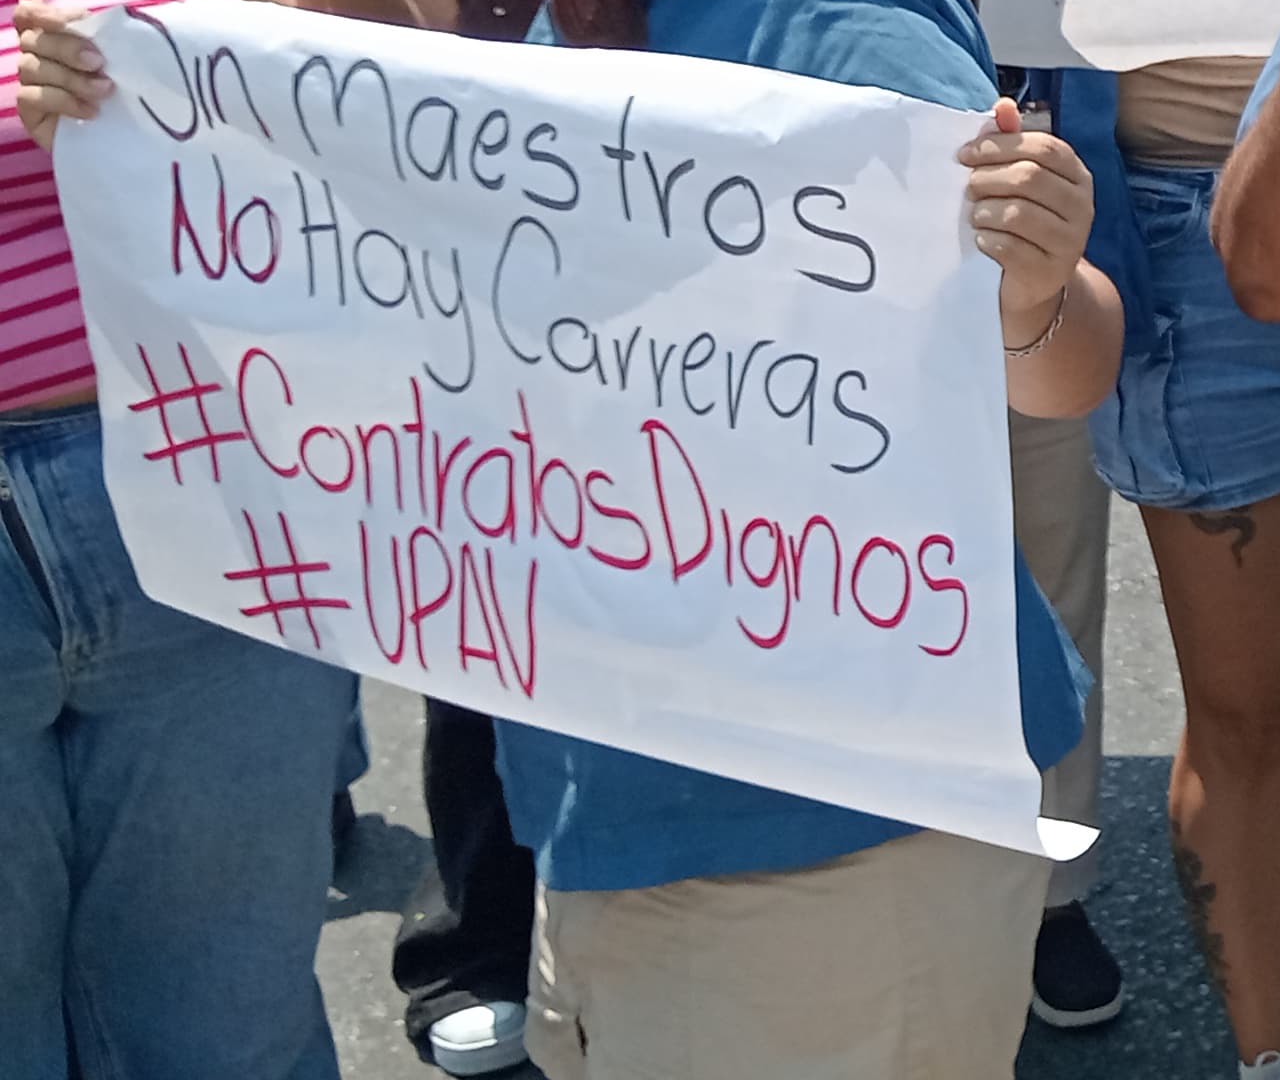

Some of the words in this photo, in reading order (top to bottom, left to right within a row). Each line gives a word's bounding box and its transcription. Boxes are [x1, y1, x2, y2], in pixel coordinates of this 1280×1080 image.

[171, 153, 282, 285] No
[293, 170, 476, 394] Hay
[491, 215, 892, 475] Carreras
[127, 341, 970, 658] #ContratosDignos
[223, 508, 539, 700] #UPAV
